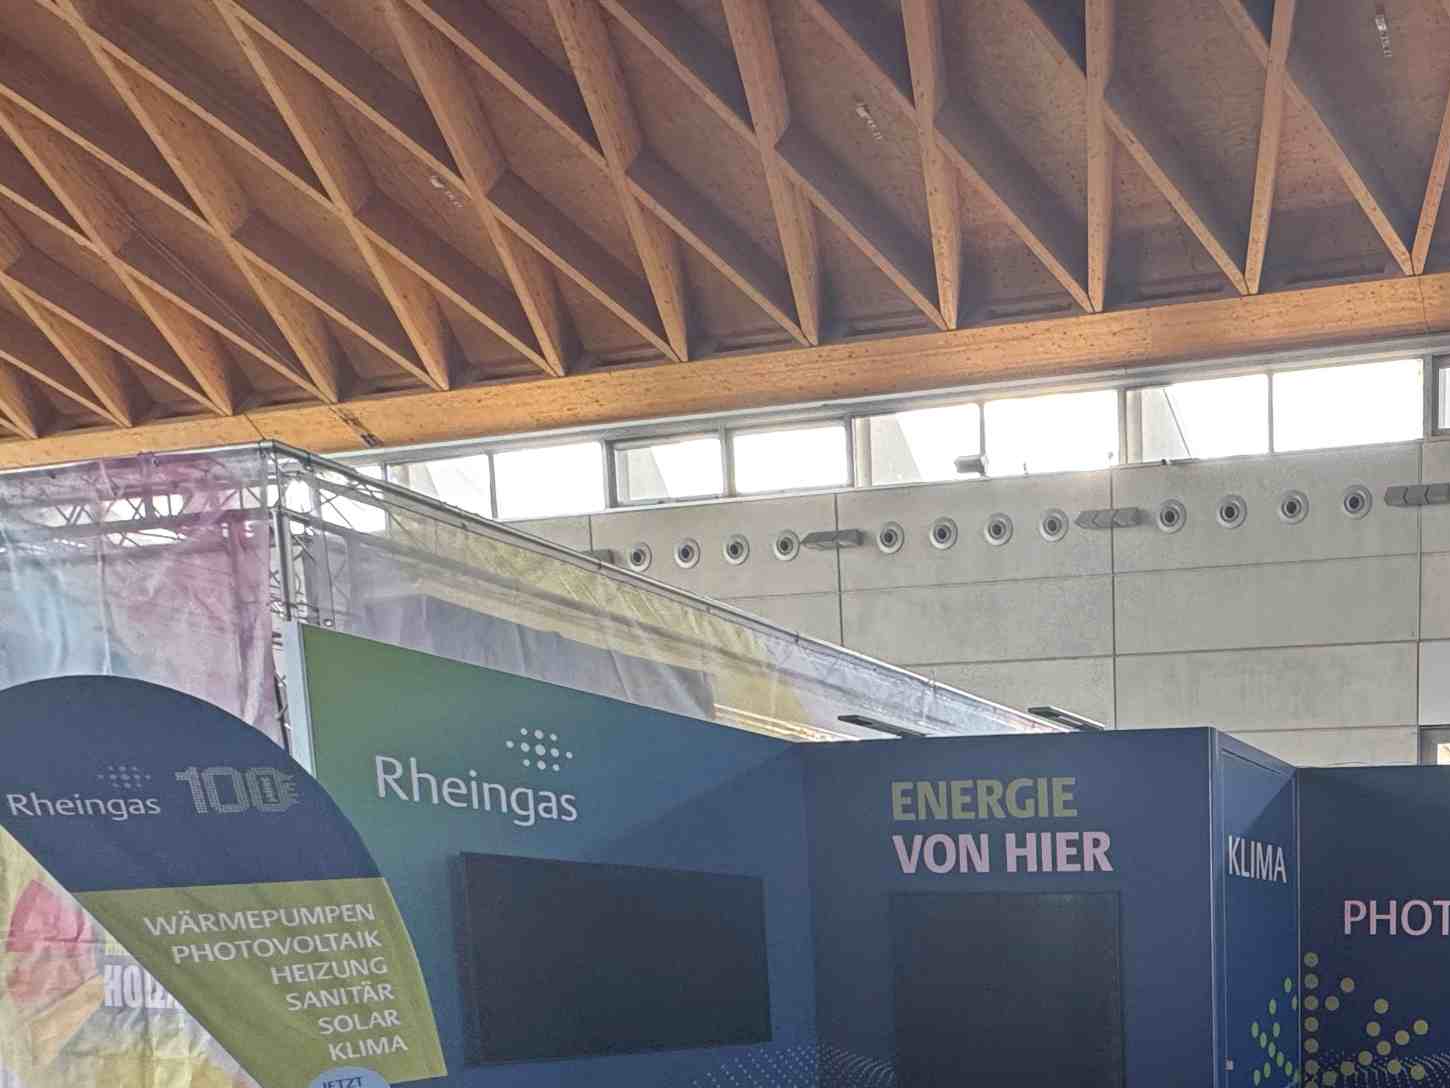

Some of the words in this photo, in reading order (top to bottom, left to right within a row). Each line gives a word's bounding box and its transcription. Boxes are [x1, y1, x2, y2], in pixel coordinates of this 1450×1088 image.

[6, 792, 161, 821] Rheingas
[175, 766, 297, 813] 100
[375, 755, 578, 826] Rheingas
[890, 776, 1078, 821] ENERGIE
[892, 833, 990, 874] VON
[1005, 831, 1114, 873] HIER
[1228, 835, 1288, 883] KLIMA
[143, 902, 376, 936] WÄRMEPUMPEN
[171, 930, 383, 964] PHOTOVOLTAIK
[270, 957, 389, 985] HEIZUNG
[285, 981, 395, 1011] SANITÄR
[318, 1009, 401, 1035] SOLAR
[327, 1034, 409, 1061] KLIMA
